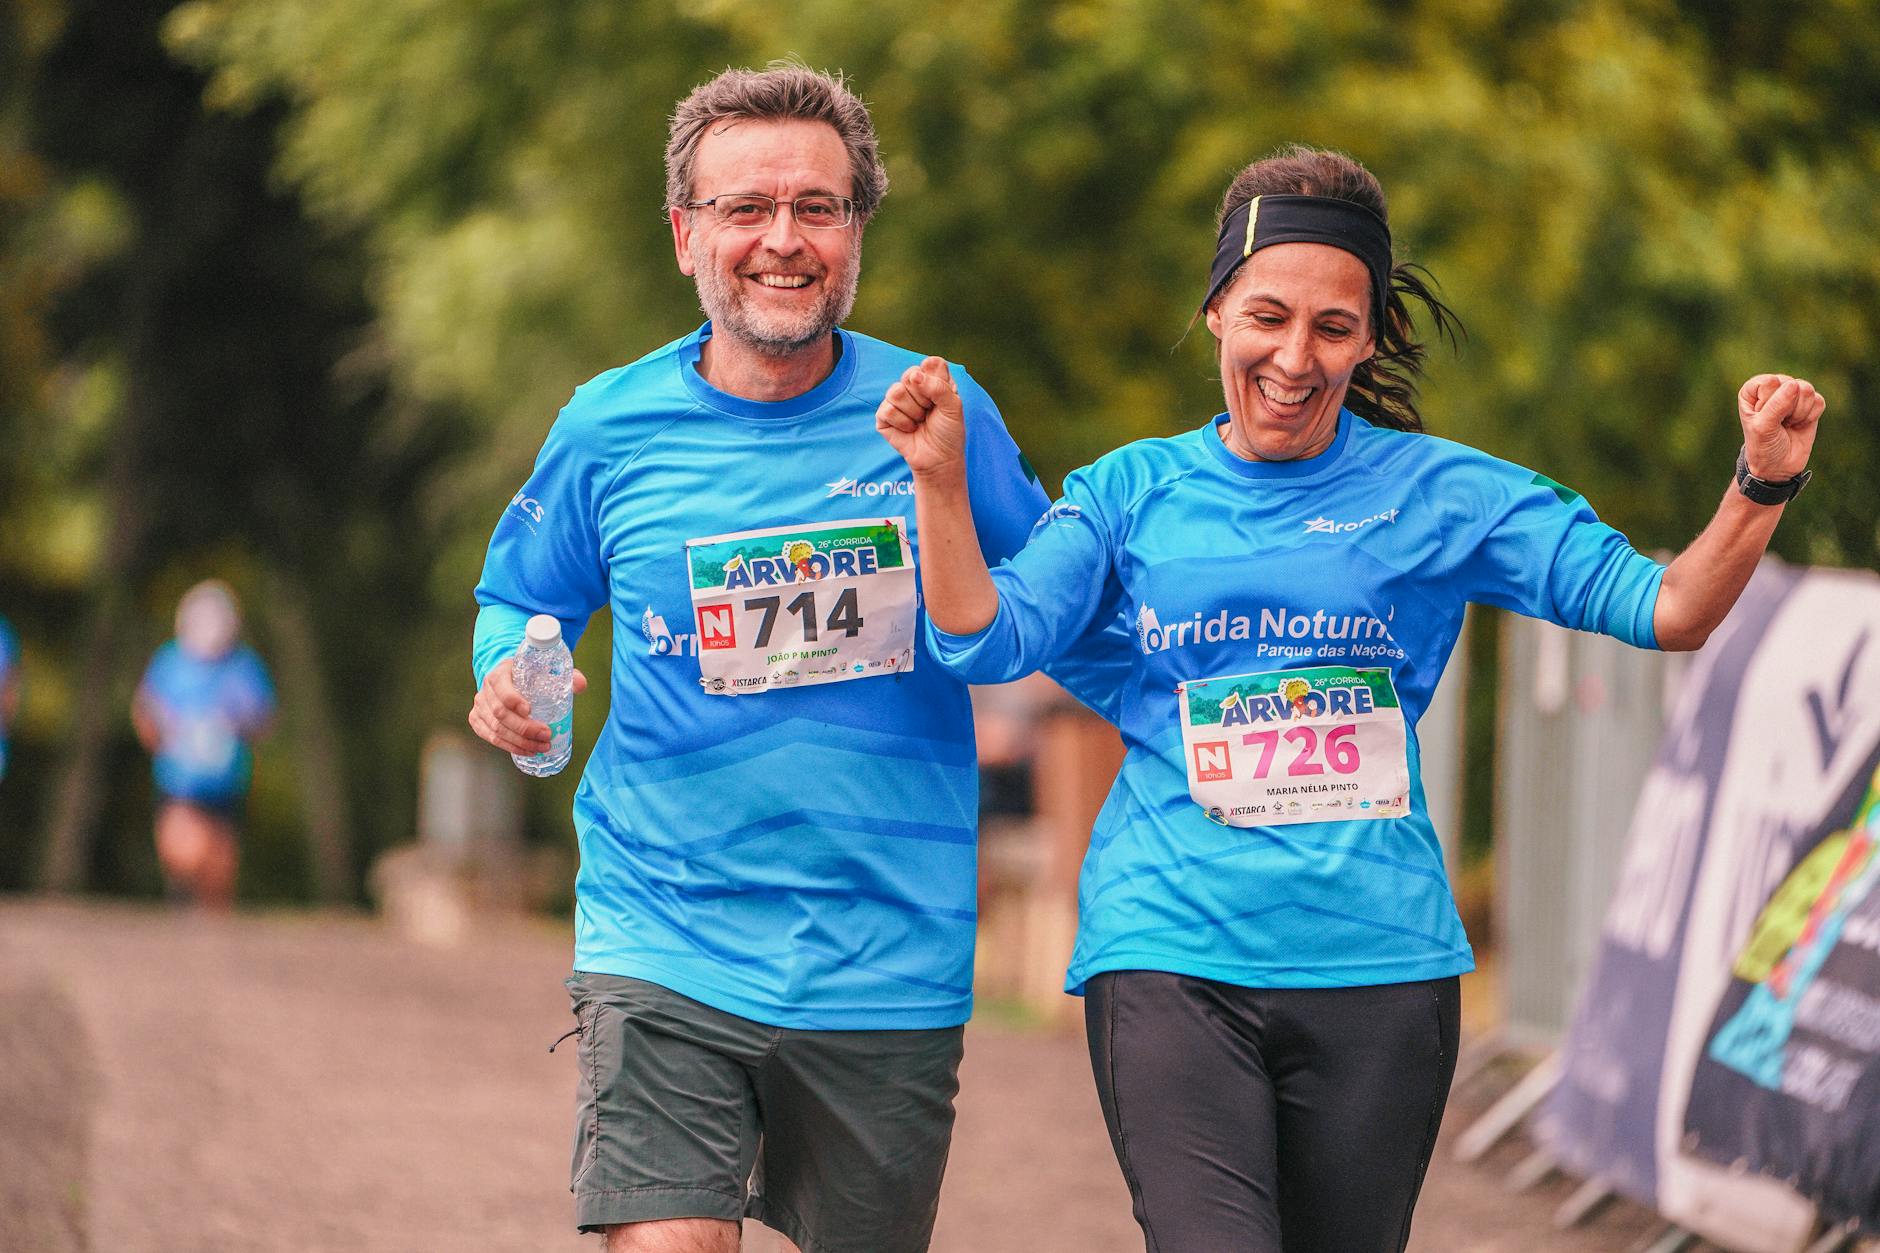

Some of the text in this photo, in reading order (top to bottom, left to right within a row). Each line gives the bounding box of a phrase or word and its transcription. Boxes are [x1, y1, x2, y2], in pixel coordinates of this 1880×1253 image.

[833, 537, 873, 547] CORRIDA
[701, 609, 731, 638] N
[744, 588, 864, 648] 714
[767, 648, 838, 665] JOÃO P M PINTO
[1257, 643, 1405, 660] Parque das Nações
[1329, 677, 1367, 686] CORRIDA
[1197, 746, 1227, 772] N
[1242, 725, 1361, 779] 726
[1266, 783, 1359, 797] MARIA NÉLIA PINTO
[1229, 805, 1266, 816] XISTARCA
